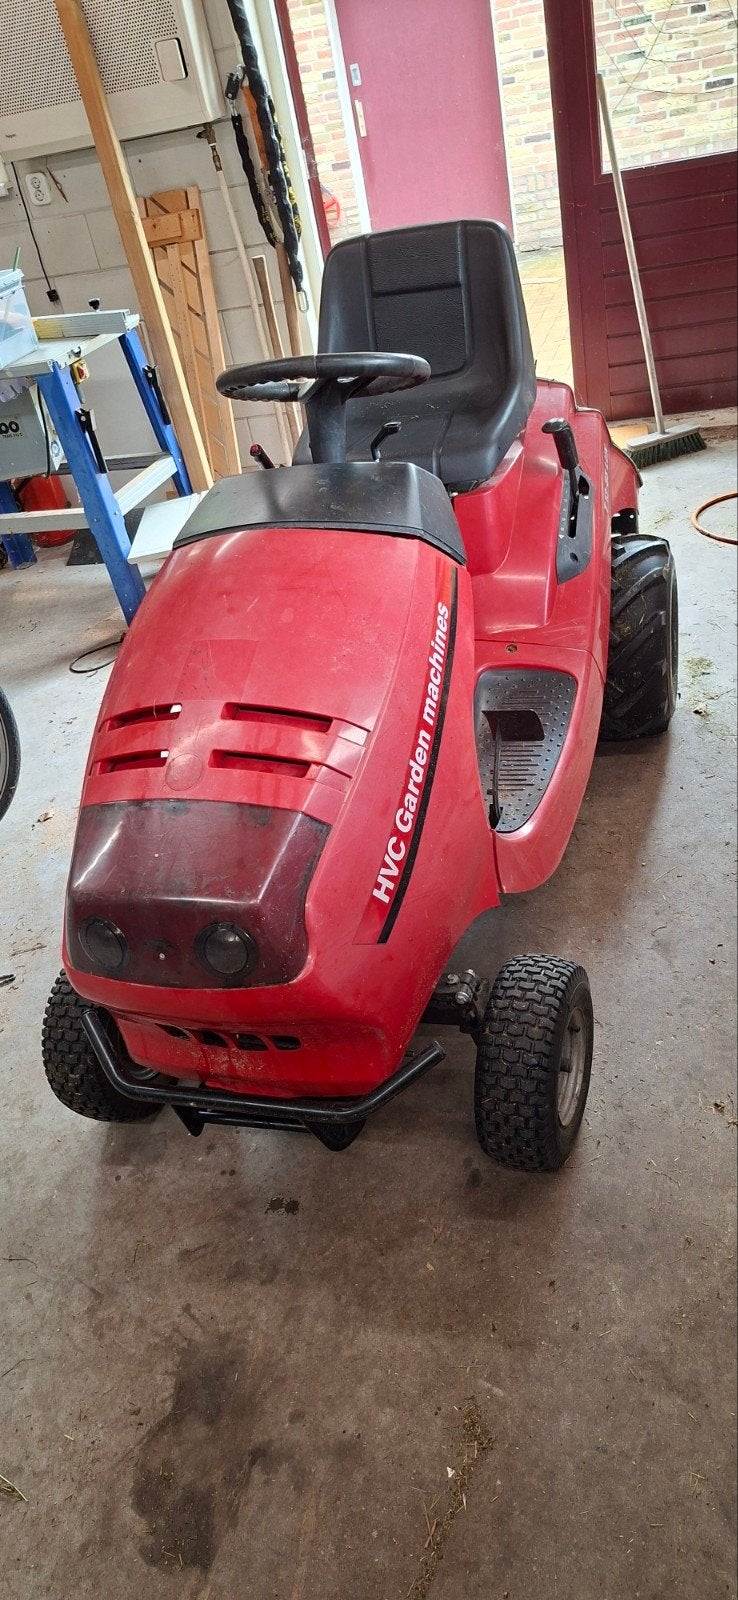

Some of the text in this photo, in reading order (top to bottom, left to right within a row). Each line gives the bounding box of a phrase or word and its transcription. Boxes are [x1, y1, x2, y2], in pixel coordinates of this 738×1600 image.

[372, 601, 449, 904] HVC Garden machines
